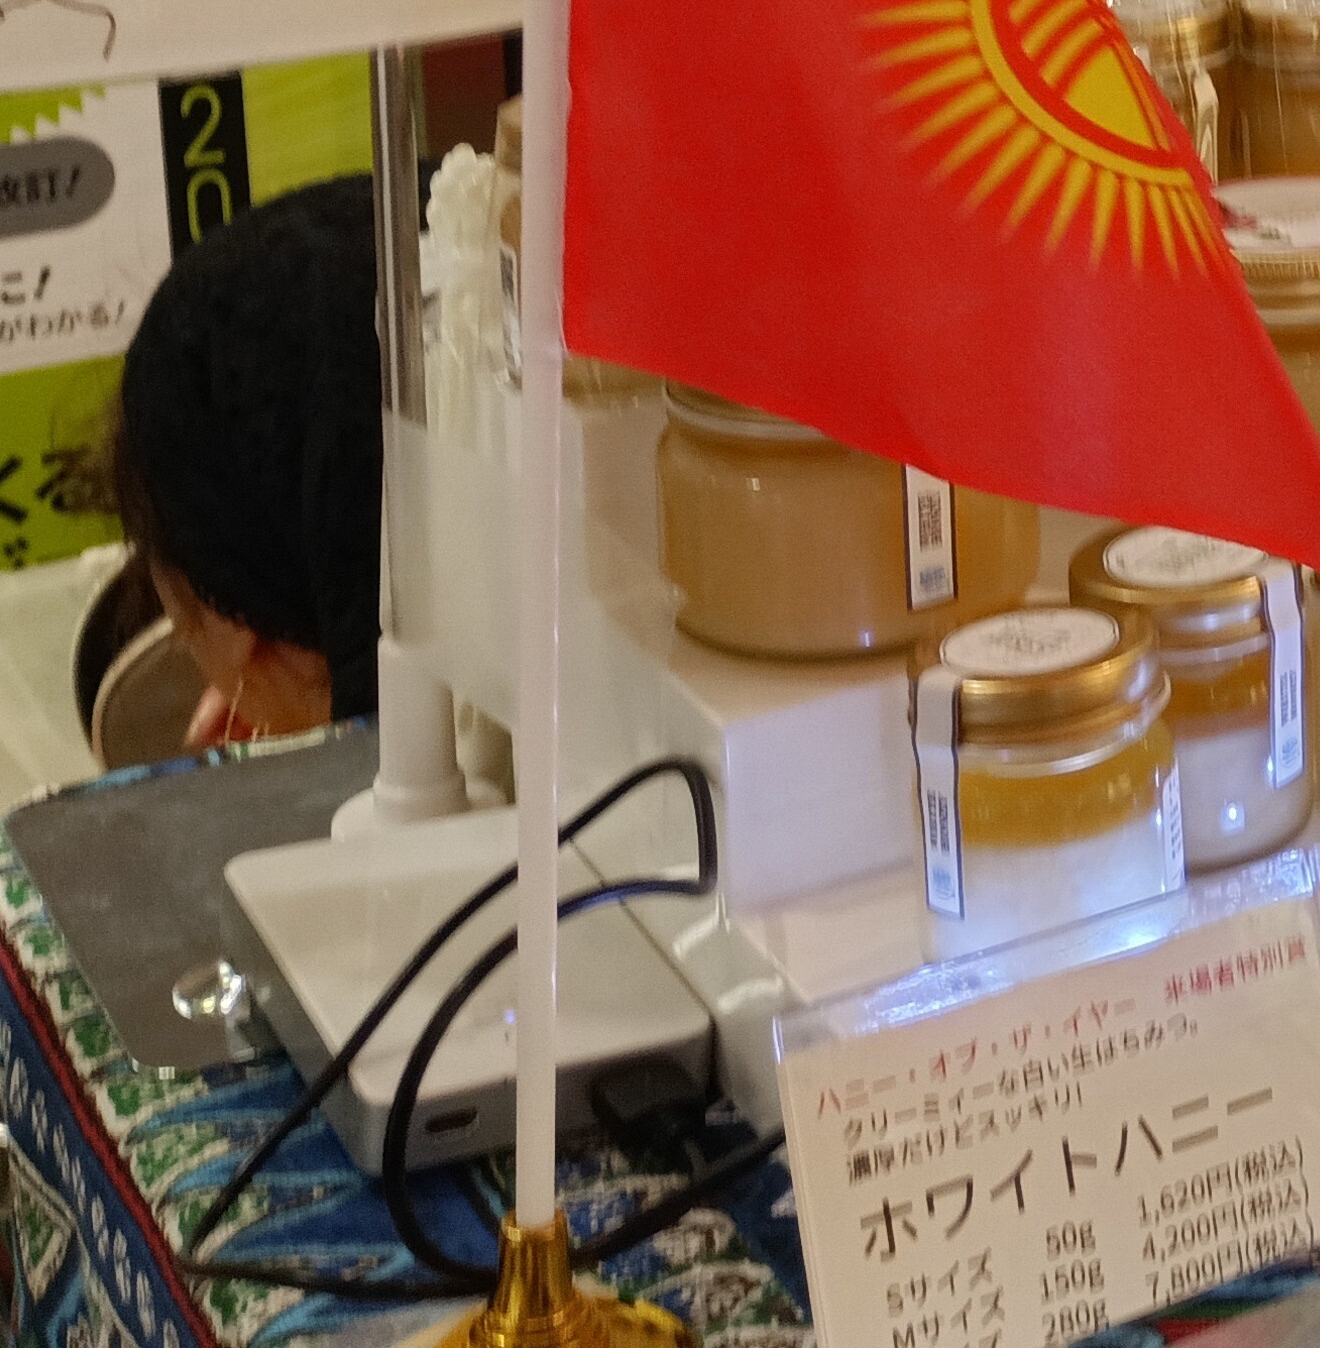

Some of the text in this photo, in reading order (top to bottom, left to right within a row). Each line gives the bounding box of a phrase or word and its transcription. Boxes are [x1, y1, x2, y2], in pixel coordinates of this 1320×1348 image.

[817, 998, 1137, 1119] ハニー・オブ・ザ・イヤー
[860, 1086, 1274, 1263] ホワイトハニー
[886, 1135, 1305, 1312] Sサイズ 50g 1,620円(税込)
[892, 1178, 1310, 1348] Mサイズ 150g 4,200円(税込)
